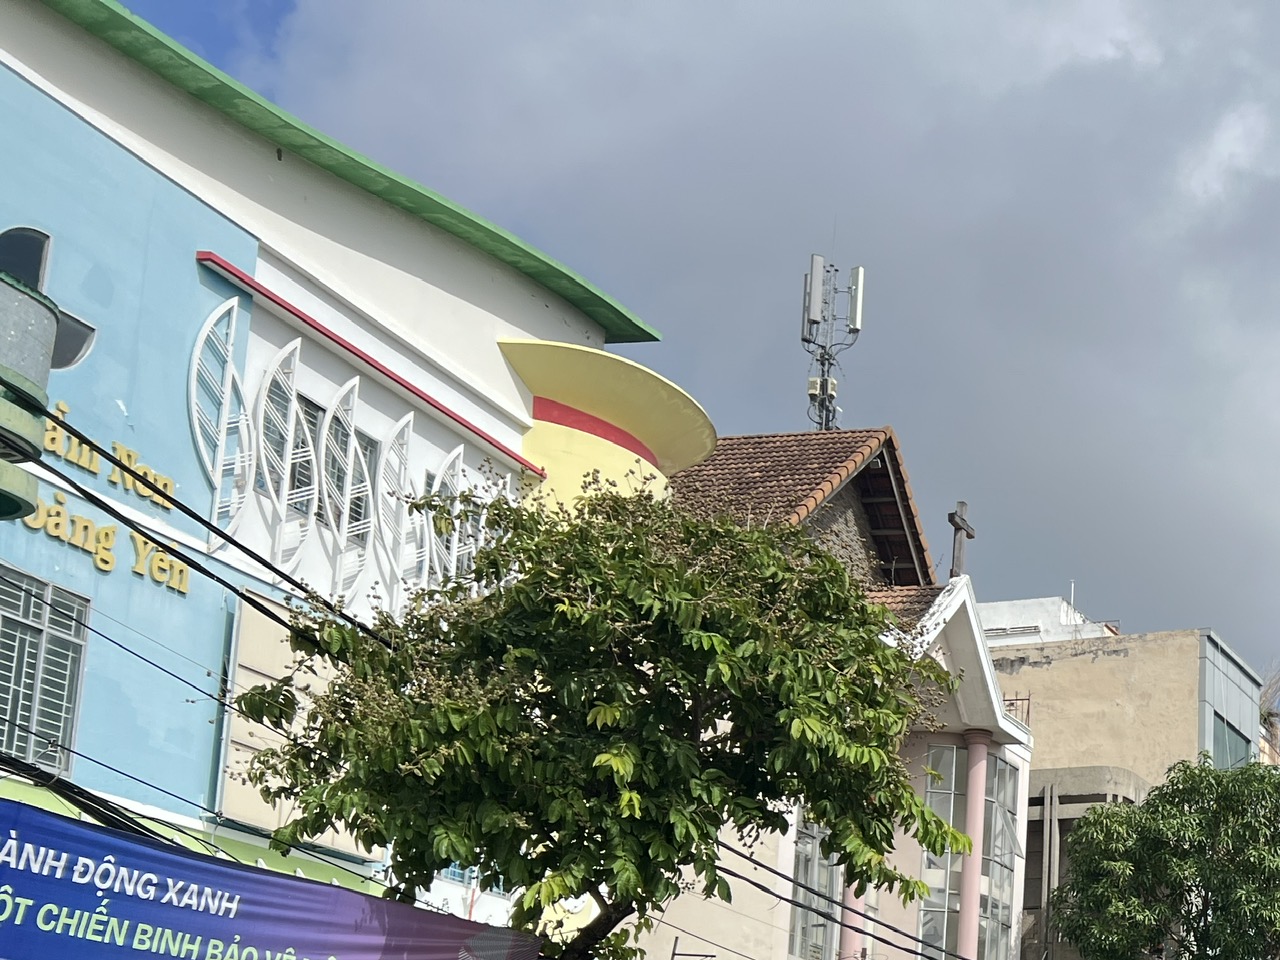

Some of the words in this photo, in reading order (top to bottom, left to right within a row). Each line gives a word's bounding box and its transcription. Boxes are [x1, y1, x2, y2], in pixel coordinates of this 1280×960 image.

[107, 440, 175, 510] Non
[22, 490, 117, 572] oàng
[130, 530, 190, 594] Yến
[72, 855, 158, 900] ĐỘNG
[160, 877, 240, 918] XANH
[36, 898, 130, 946] CHIẾN
[132, 923, 202, 960] BINH
